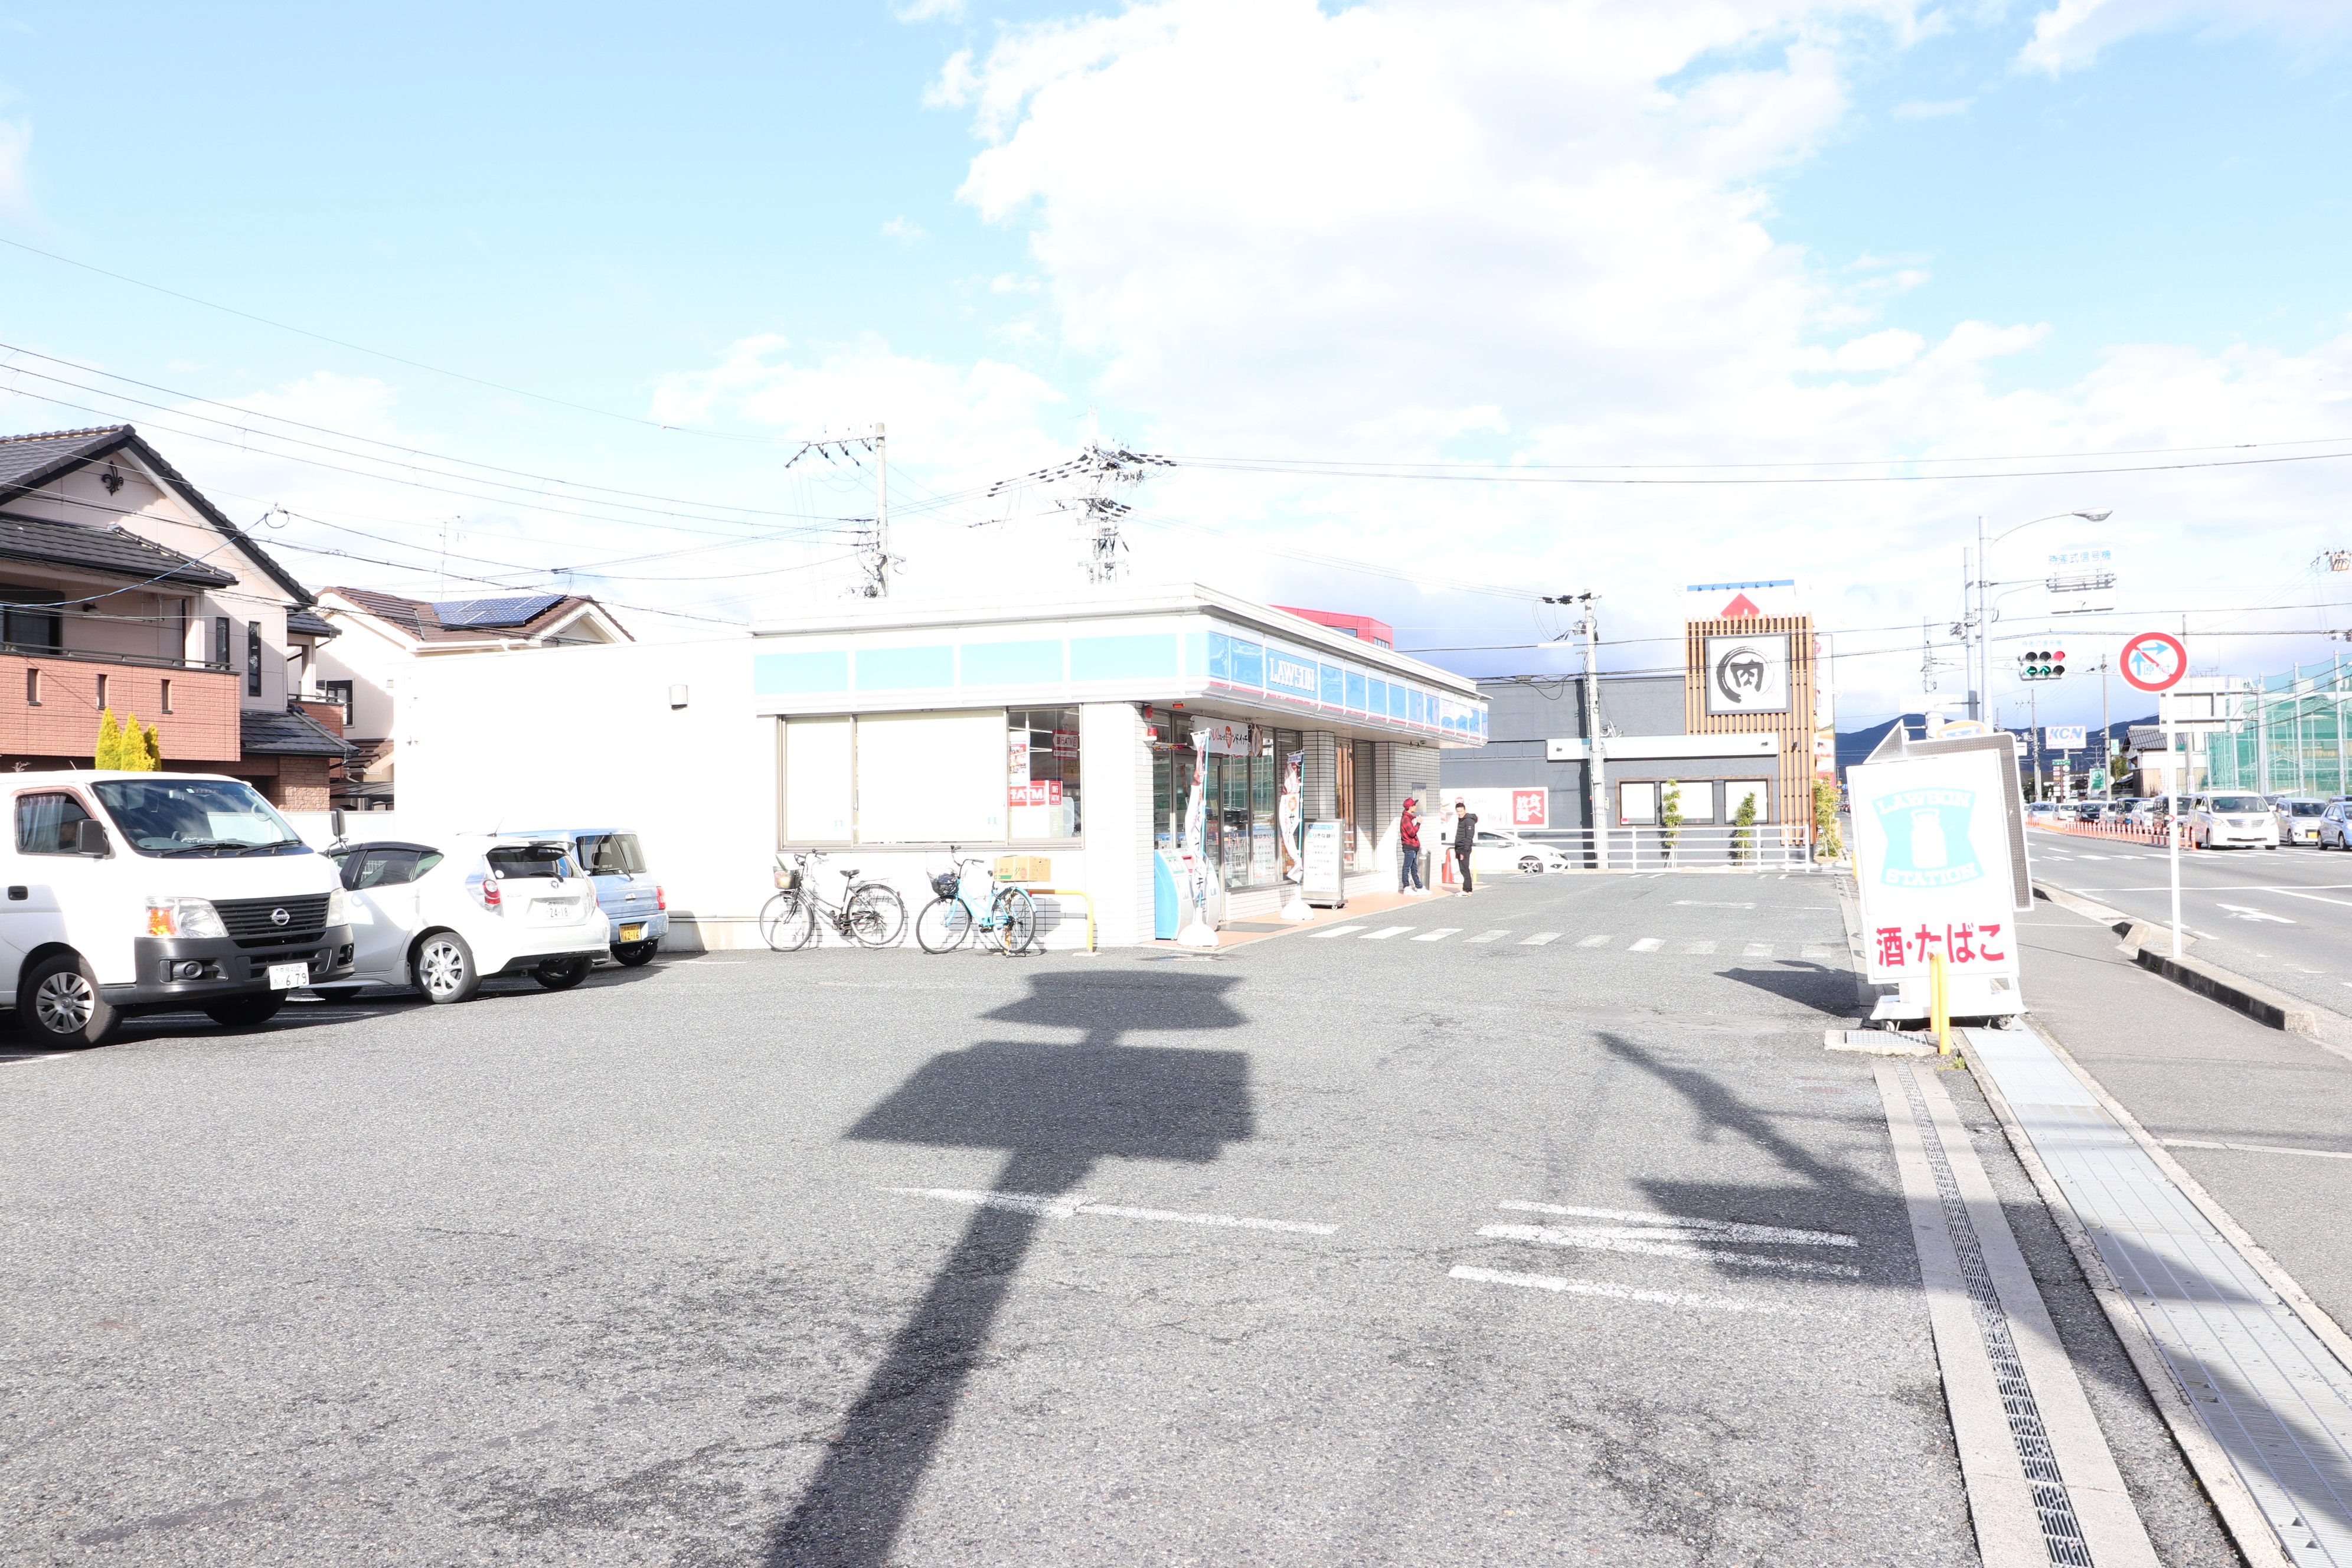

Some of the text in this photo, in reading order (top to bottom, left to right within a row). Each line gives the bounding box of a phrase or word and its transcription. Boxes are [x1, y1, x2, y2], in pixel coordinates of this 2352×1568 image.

[2049, 550, 2112, 565] 時差式信号機
[1269, 656, 1315, 692] LAWSON
[1730, 658, 1764, 692] 肉
[2144, 664, 2170, 675] 原付
[2049, 728, 2083, 739] KCN
[1515, 795, 1530, 822] 放題
[1528, 793, 1543, 818] 食べ
[1876, 790, 1972, 815] LAWSON
[1885, 862, 1978, 886] STATION
[625, 931, 639, 940] 12-16
[1876, 923, 2011, 967] 酒・たばこ
